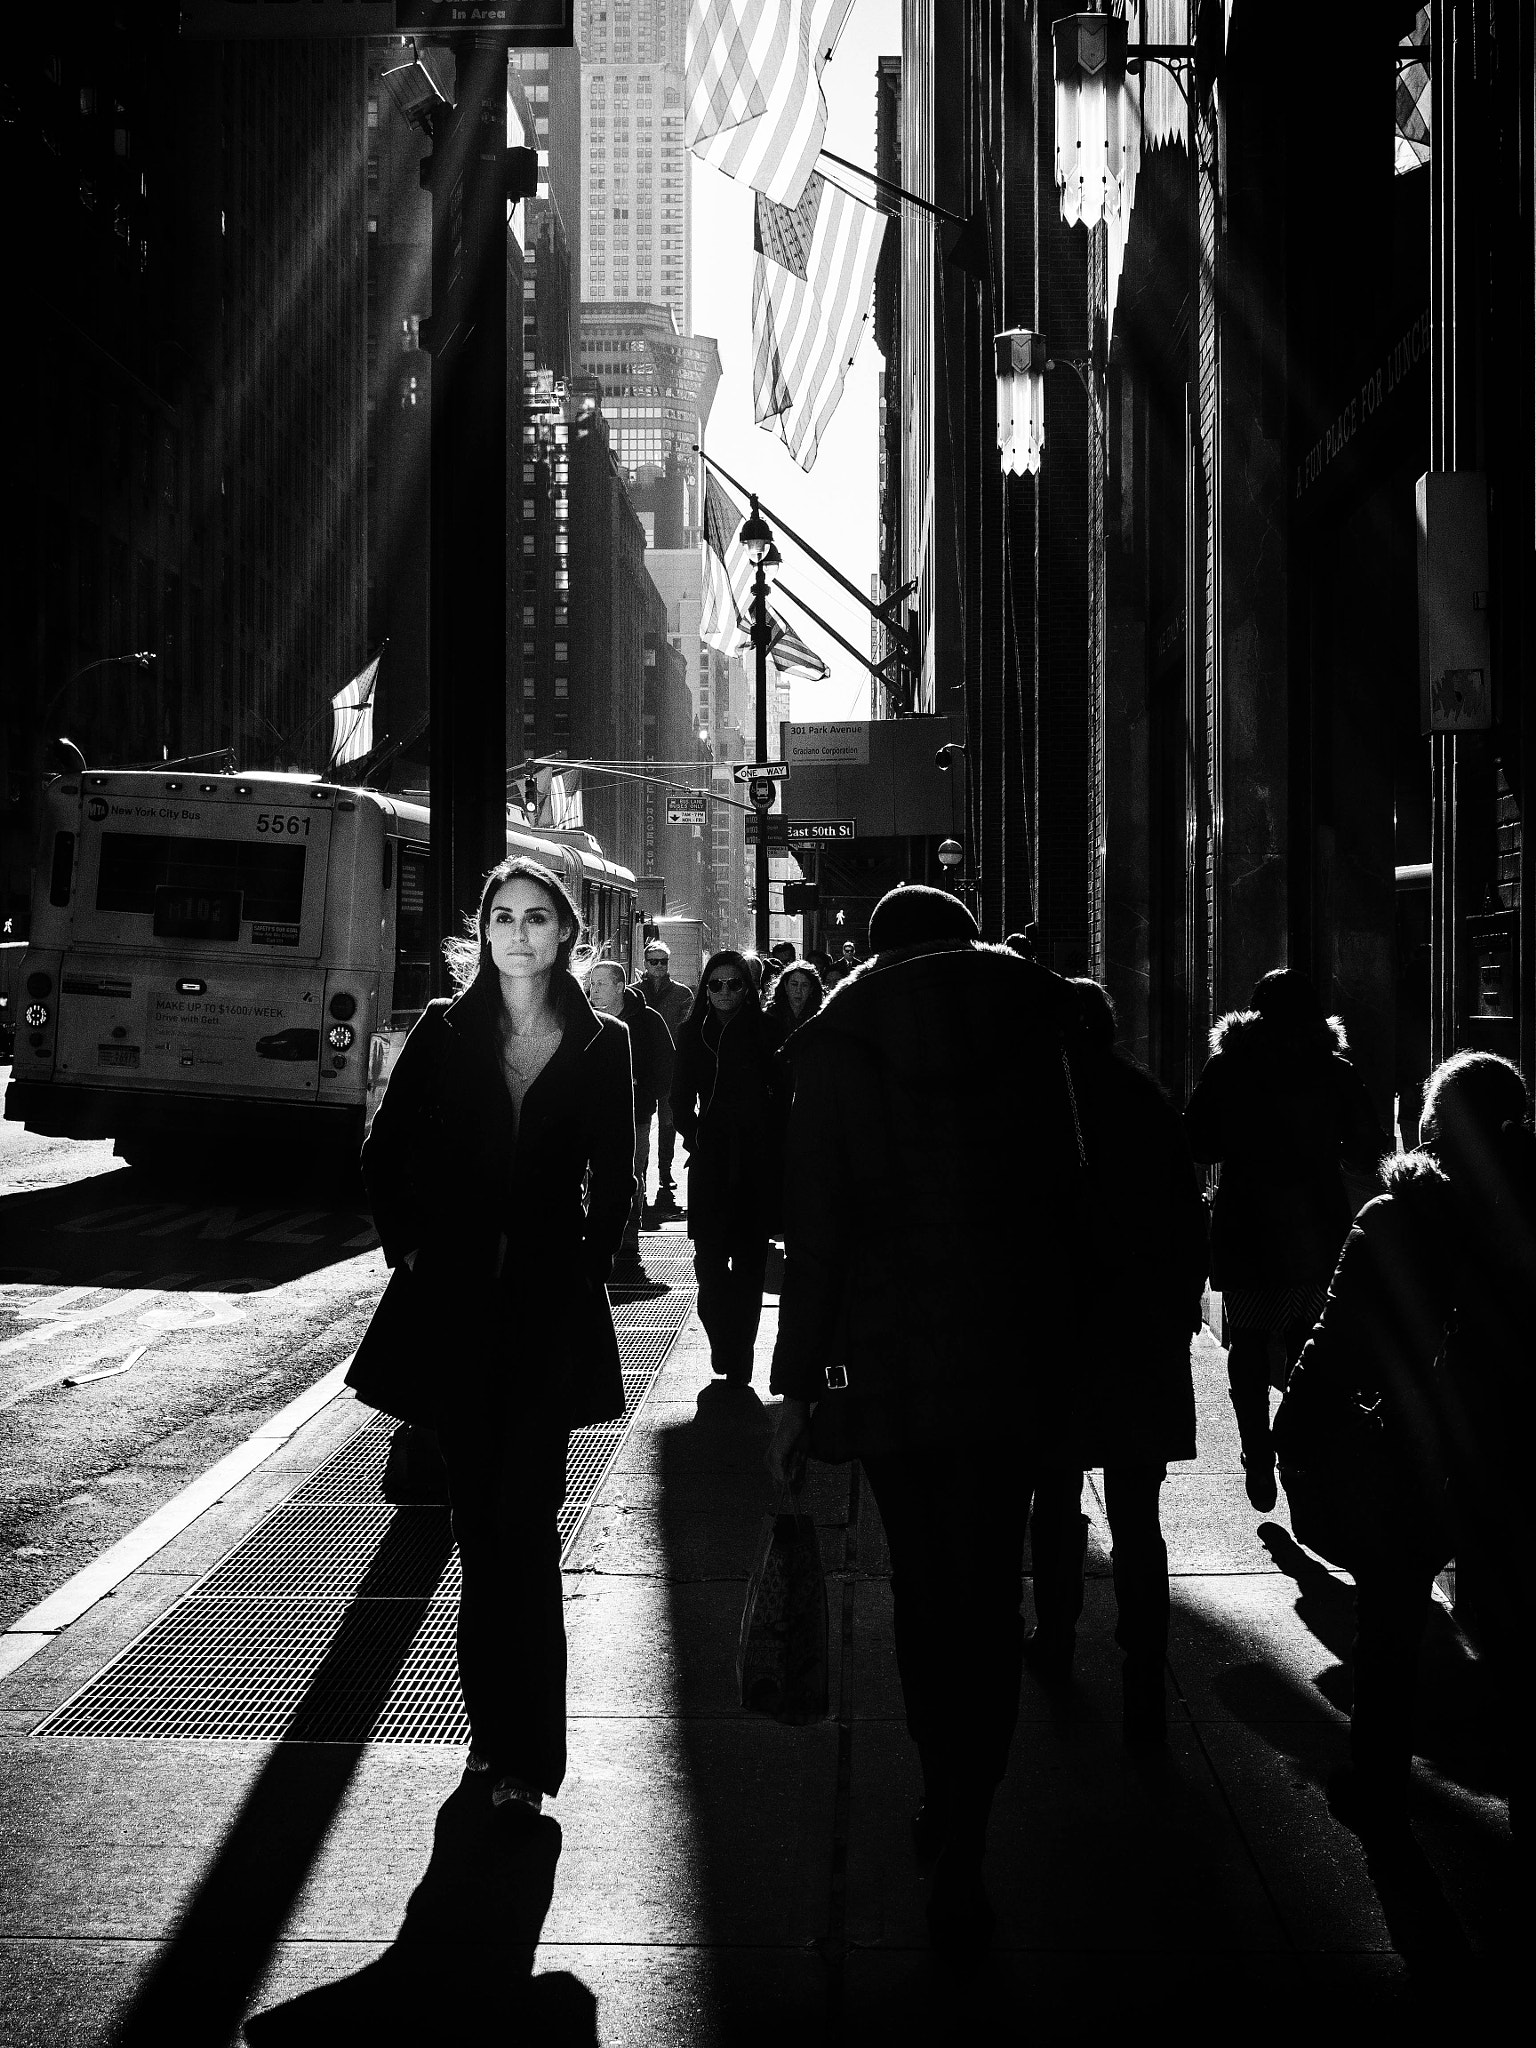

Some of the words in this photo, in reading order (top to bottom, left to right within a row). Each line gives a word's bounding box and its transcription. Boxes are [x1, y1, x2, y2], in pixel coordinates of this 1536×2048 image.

[453, 9, 466, 19] In
[471, 9, 506, 19] Area
[1305, 439, 1322, 488] FUN
[1326, 397, 1357, 464] PLACE
[1361, 367, 1383, 423] FOR
[1387, 308, 1430, 393] LUNCH
[791, 726, 806, 735] 301
[809, 726, 828, 734] Park
[830, 725, 862, 734] Avenue
[821, 746, 858, 756] Corporation
[741, 769, 758, 778] ONE
[766, 767, 785, 776] WAY
[111, 805, 132, 816] New
[135, 806, 157, 817] York
[159, 808, 179, 820] City
[181, 810, 201, 820] Bus
[257, 814, 310, 835] 5561
[812, 825, 836, 837] 50th
[839, 825, 851, 836] St
[156, 1000, 185, 1011] MAKE
[187, 1002, 202, 1012] UP
[204, 1003, 216, 1013] TO
[155, 1012, 180, 1023] Drive
[181, 1014, 199, 1024] with
